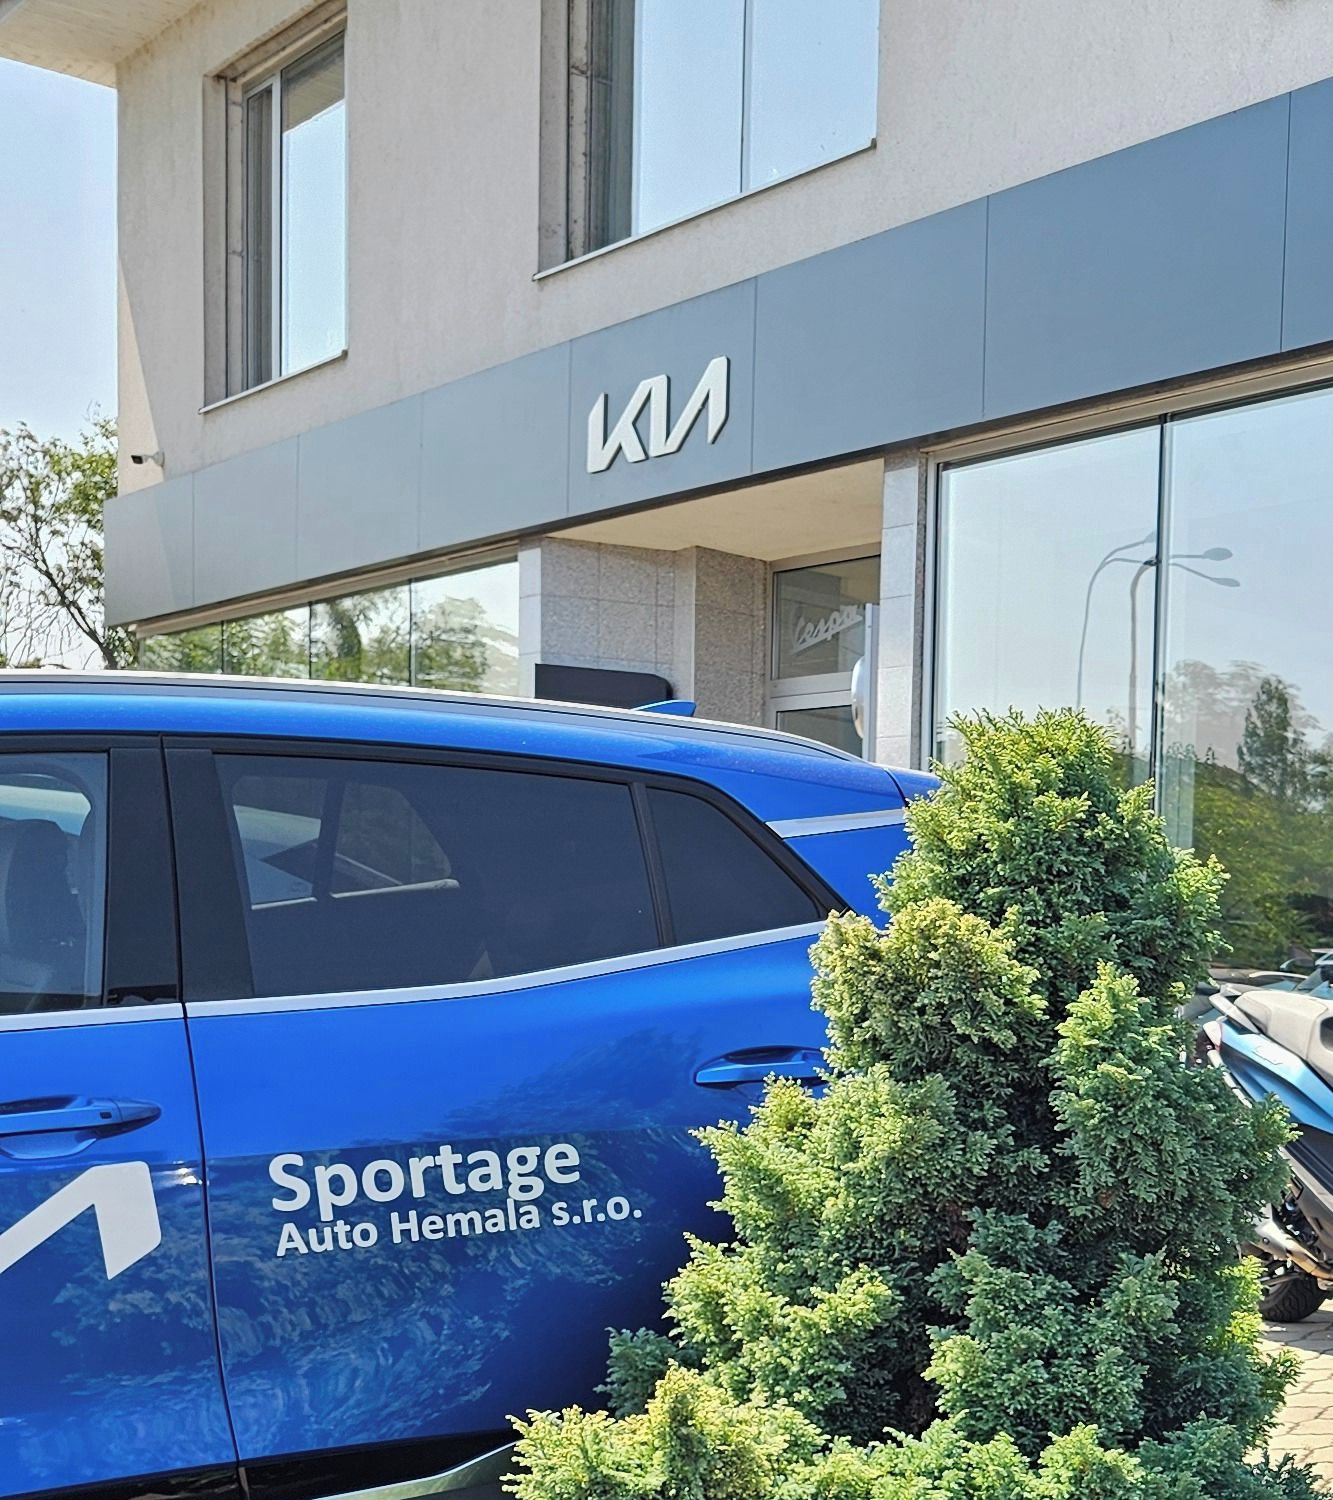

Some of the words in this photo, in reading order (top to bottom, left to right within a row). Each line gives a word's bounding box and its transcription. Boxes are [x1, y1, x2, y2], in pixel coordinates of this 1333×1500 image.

[586, 355, 731, 474] KIA
[268, 1141, 581, 1222] Sportage
[276, 1219, 379, 1257] Auto
[390, 1198, 541, 1244] Hemala
[551, 1194, 643, 1227] s.r.o.
